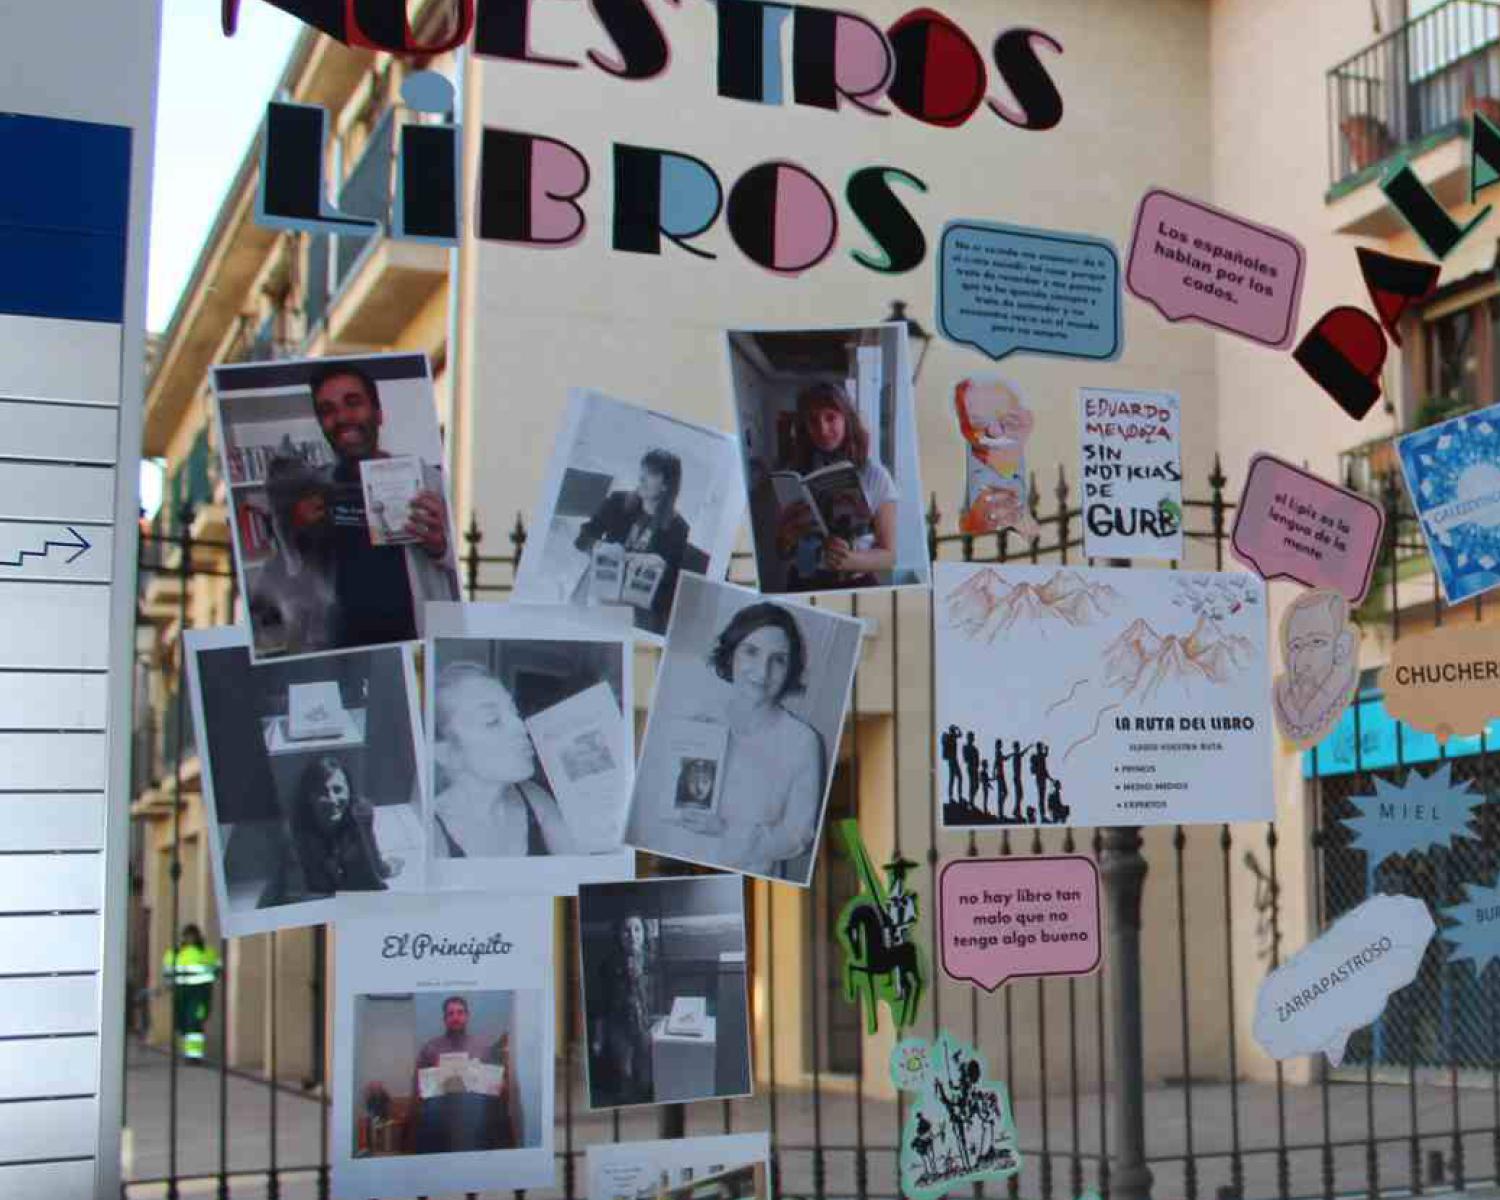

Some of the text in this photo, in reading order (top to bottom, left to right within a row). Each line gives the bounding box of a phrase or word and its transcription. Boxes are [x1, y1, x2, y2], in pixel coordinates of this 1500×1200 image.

[1158, 221, 1278, 278] Los españoles
[1154, 241, 1274, 297] hablan por los
[1182, 274, 1239, 304] codos.
[1085, 398, 1171, 423] EDUARDO
[1083, 444, 1122, 461] SIN
[1084, 461, 1182, 482] NOTICIAS
[1085, 483, 1113, 498] DE
[1087, 499, 1179, 538] GURB
[1268, 506, 1347, 552] lengua de la
[1114, 716, 1255, 731] LA RUTA DEL LIBRO
[1378, 802, 1440, 819] MIEL
[959, 889, 1081, 906] no hay libro tan
[973, 911, 1069, 926] malo que no
[381, 932, 515, 964] El Principito
[954, 930, 1089, 950] tenga algo bueno
[1276, 936, 1392, 1022] ZARRAPASTROSO
